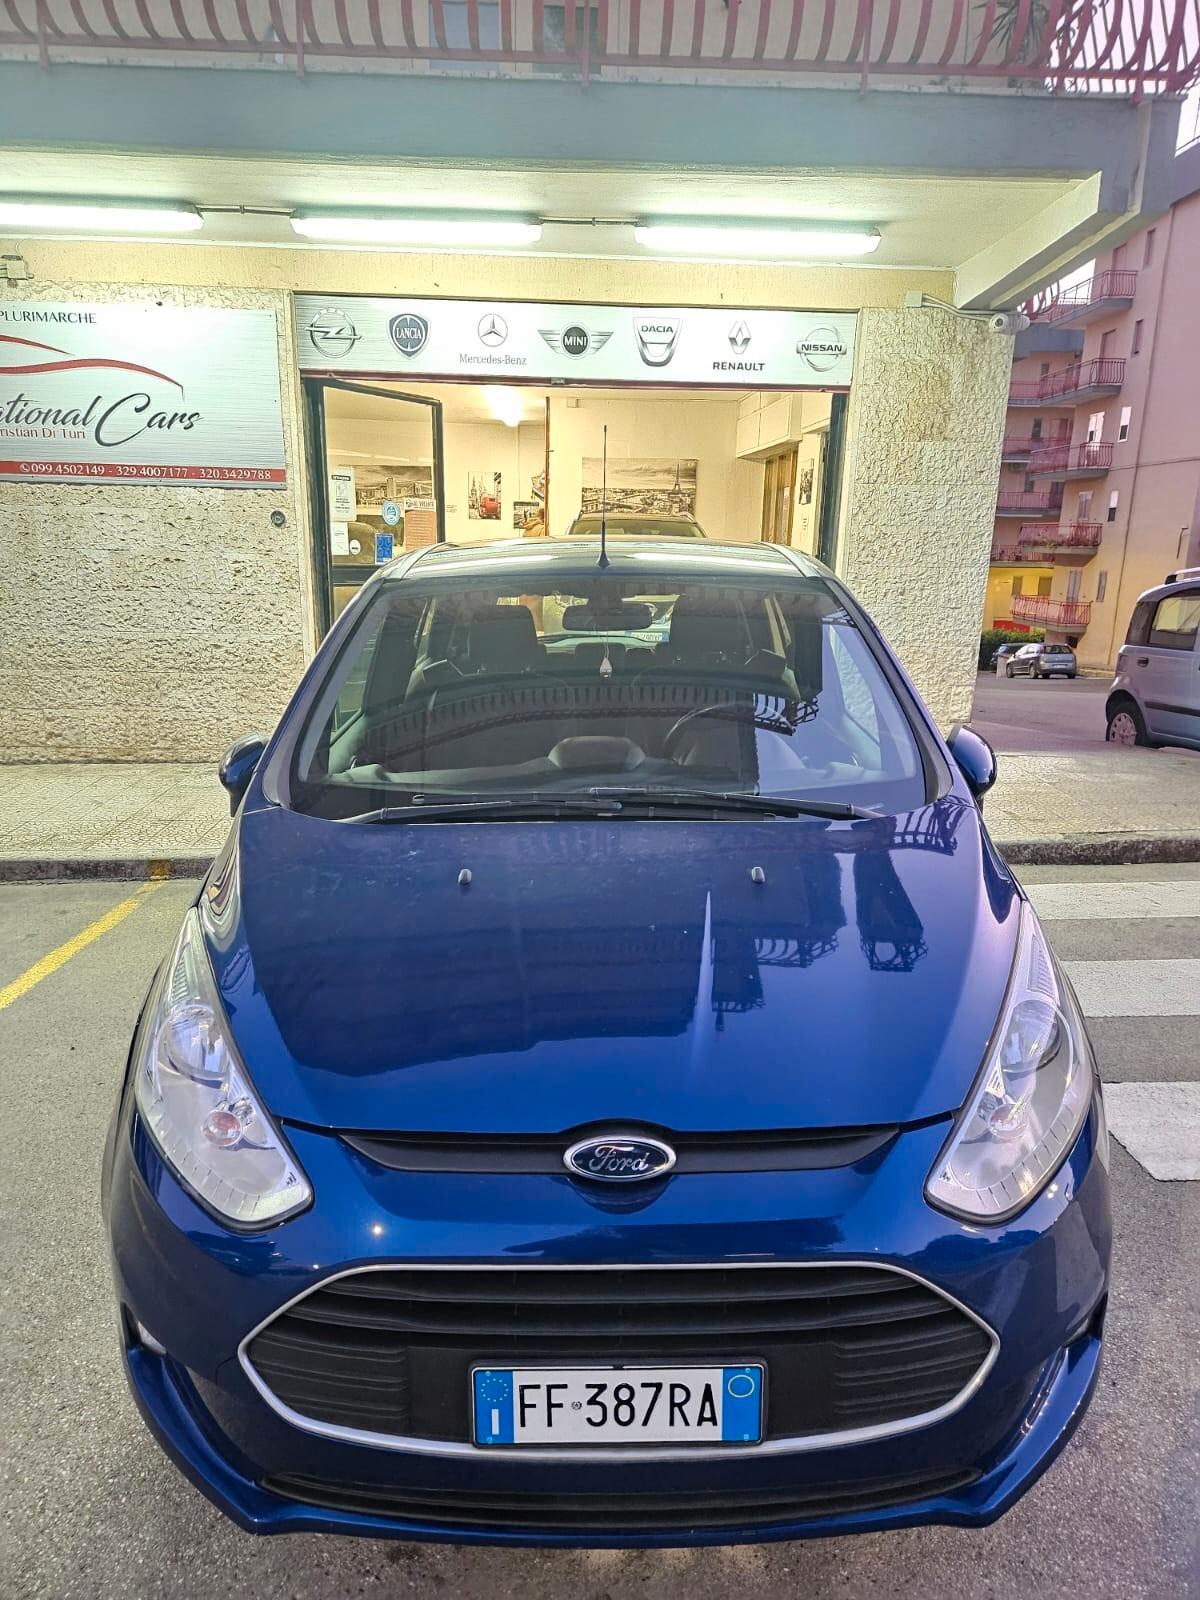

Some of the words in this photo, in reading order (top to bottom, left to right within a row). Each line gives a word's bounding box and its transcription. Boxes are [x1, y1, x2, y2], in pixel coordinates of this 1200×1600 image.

[396, 327, 422, 339] LANCIA
[641, 325, 674, 333] DACIA
[563, 335, 587, 347] MINI
[801, 343, 842, 352] NISSAN
[459, 353, 527, 366] Mercedes-Benz
[713, 361, 765, 371] RENAULT
[94, 392, 203, 447] Cars
[42, 428, 56, 439] Di
[61, 428, 86, 439] Turi
[31, 463, 105, 476] 099.4502149
[116, 465, 188, 478] 329.4007177
[199, 467, 272, 481] 320.3429788
[589, 1145, 650, 1171] Ford
